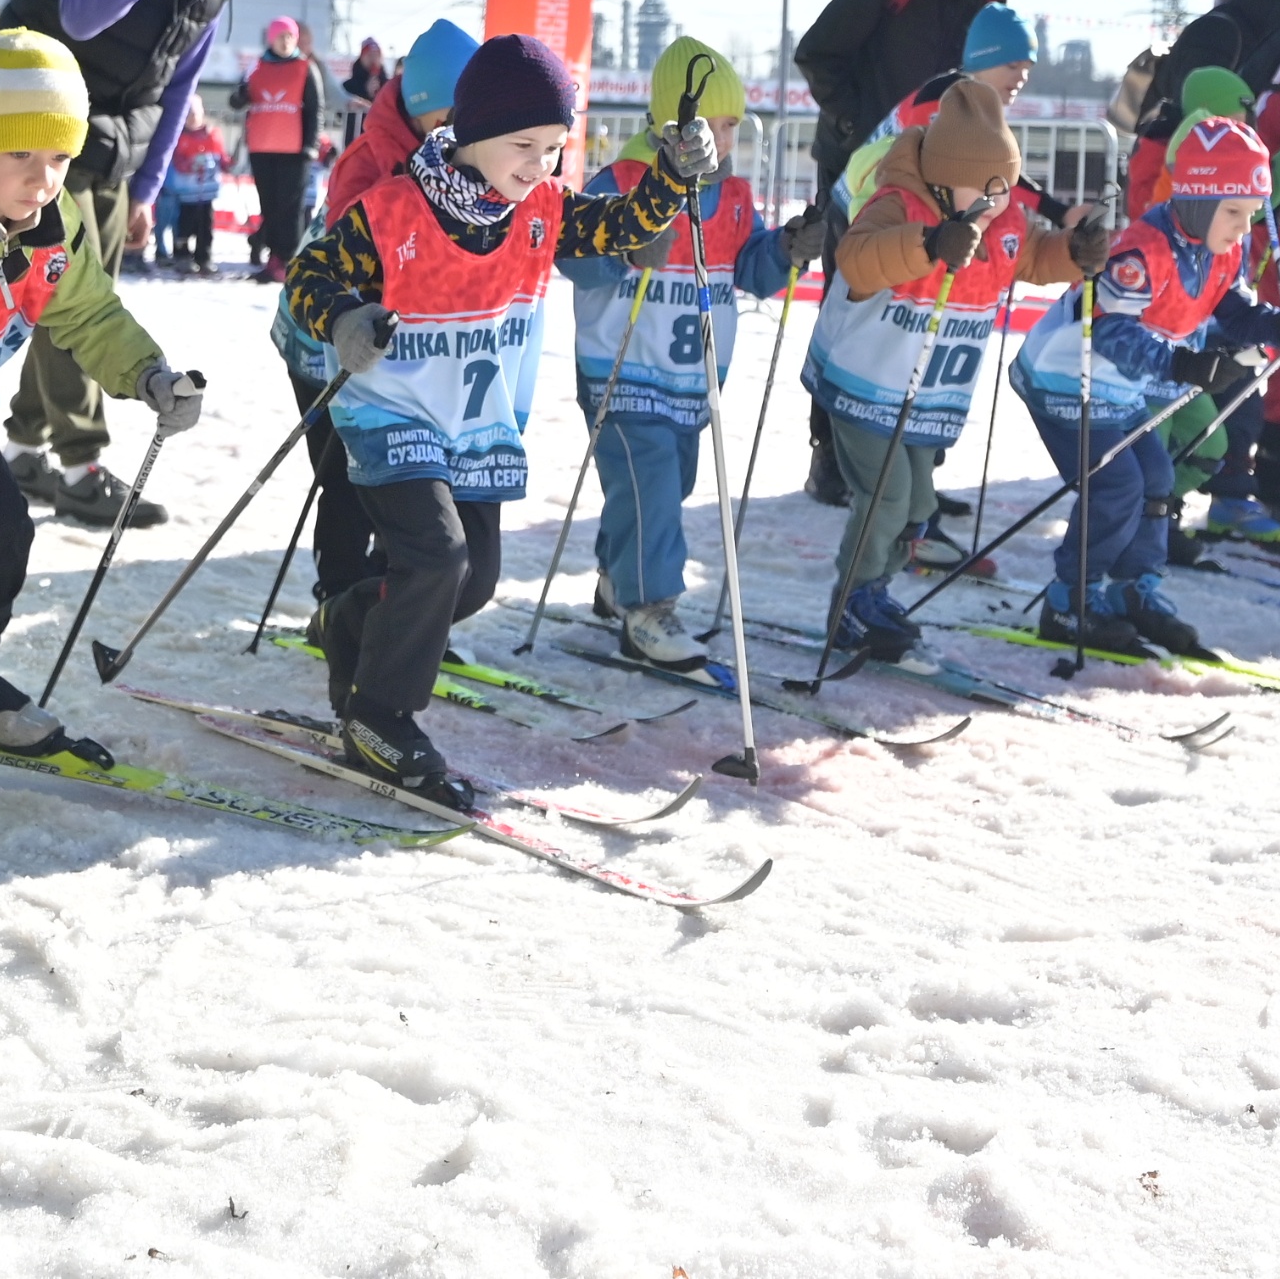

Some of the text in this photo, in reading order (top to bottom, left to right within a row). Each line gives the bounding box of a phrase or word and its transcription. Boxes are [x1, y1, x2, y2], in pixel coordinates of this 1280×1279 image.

[668, 313, 703, 366] 8
[880, 303, 939, 337] ГОНК
[386, 331, 450, 361] ОНКА
[921, 343, 983, 389] 10
[463, 359, 500, 421] 7
[387, 429, 430, 446] ПАМЯТИ
[349, 719, 404, 765] FISCHER
[369, 779, 397, 799] TISA
